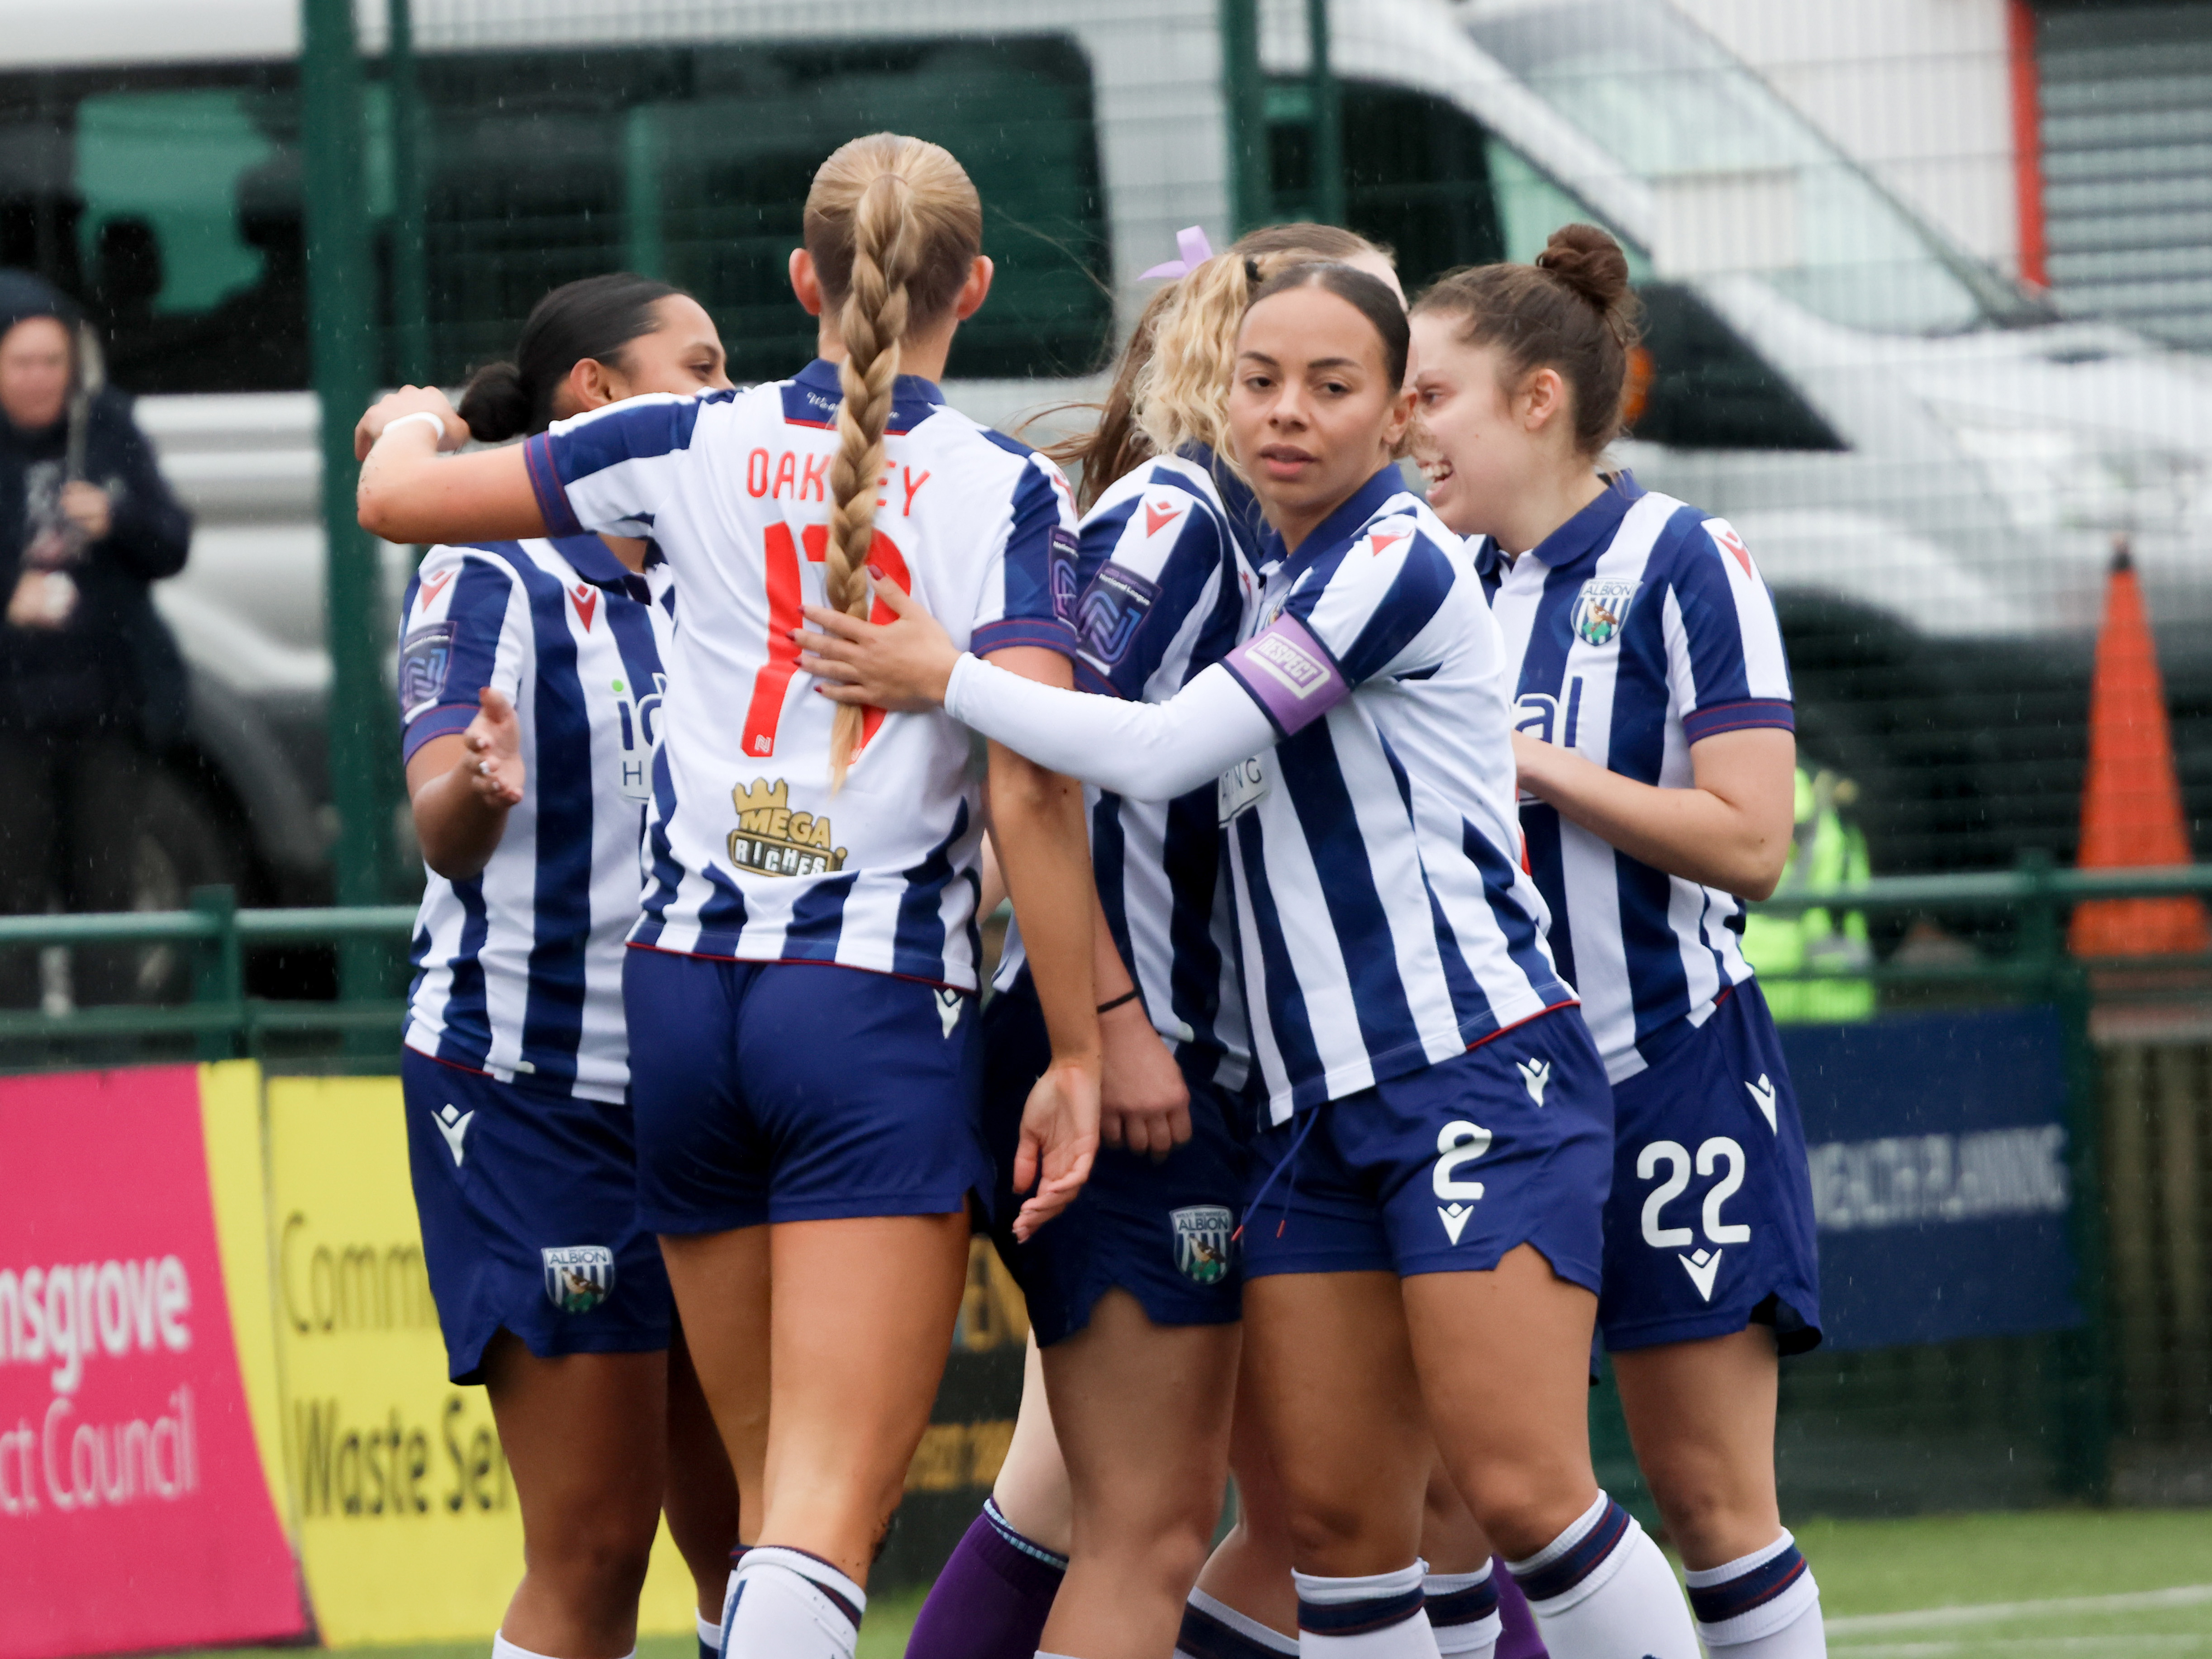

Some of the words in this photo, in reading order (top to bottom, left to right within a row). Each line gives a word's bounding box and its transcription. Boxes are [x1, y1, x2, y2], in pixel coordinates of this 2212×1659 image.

[747, 447, 931, 517] OAKY
[1583, 585, 1633, 595] ALBION
[1257, 637, 1318, 682] RESPECT
[739, 808, 831, 849] MEGA
[735, 838, 826, 876] RICHES
[1432, 1120, 1493, 1200] 2
[1636, 1136, 1751, 1248] 22
[1178, 1217, 1228, 1231] ALBION
[550, 1250, 607, 1264] ALBION
[43, 1384, 199, 1512] Council
[293, 1396, 431, 1516] Waste
